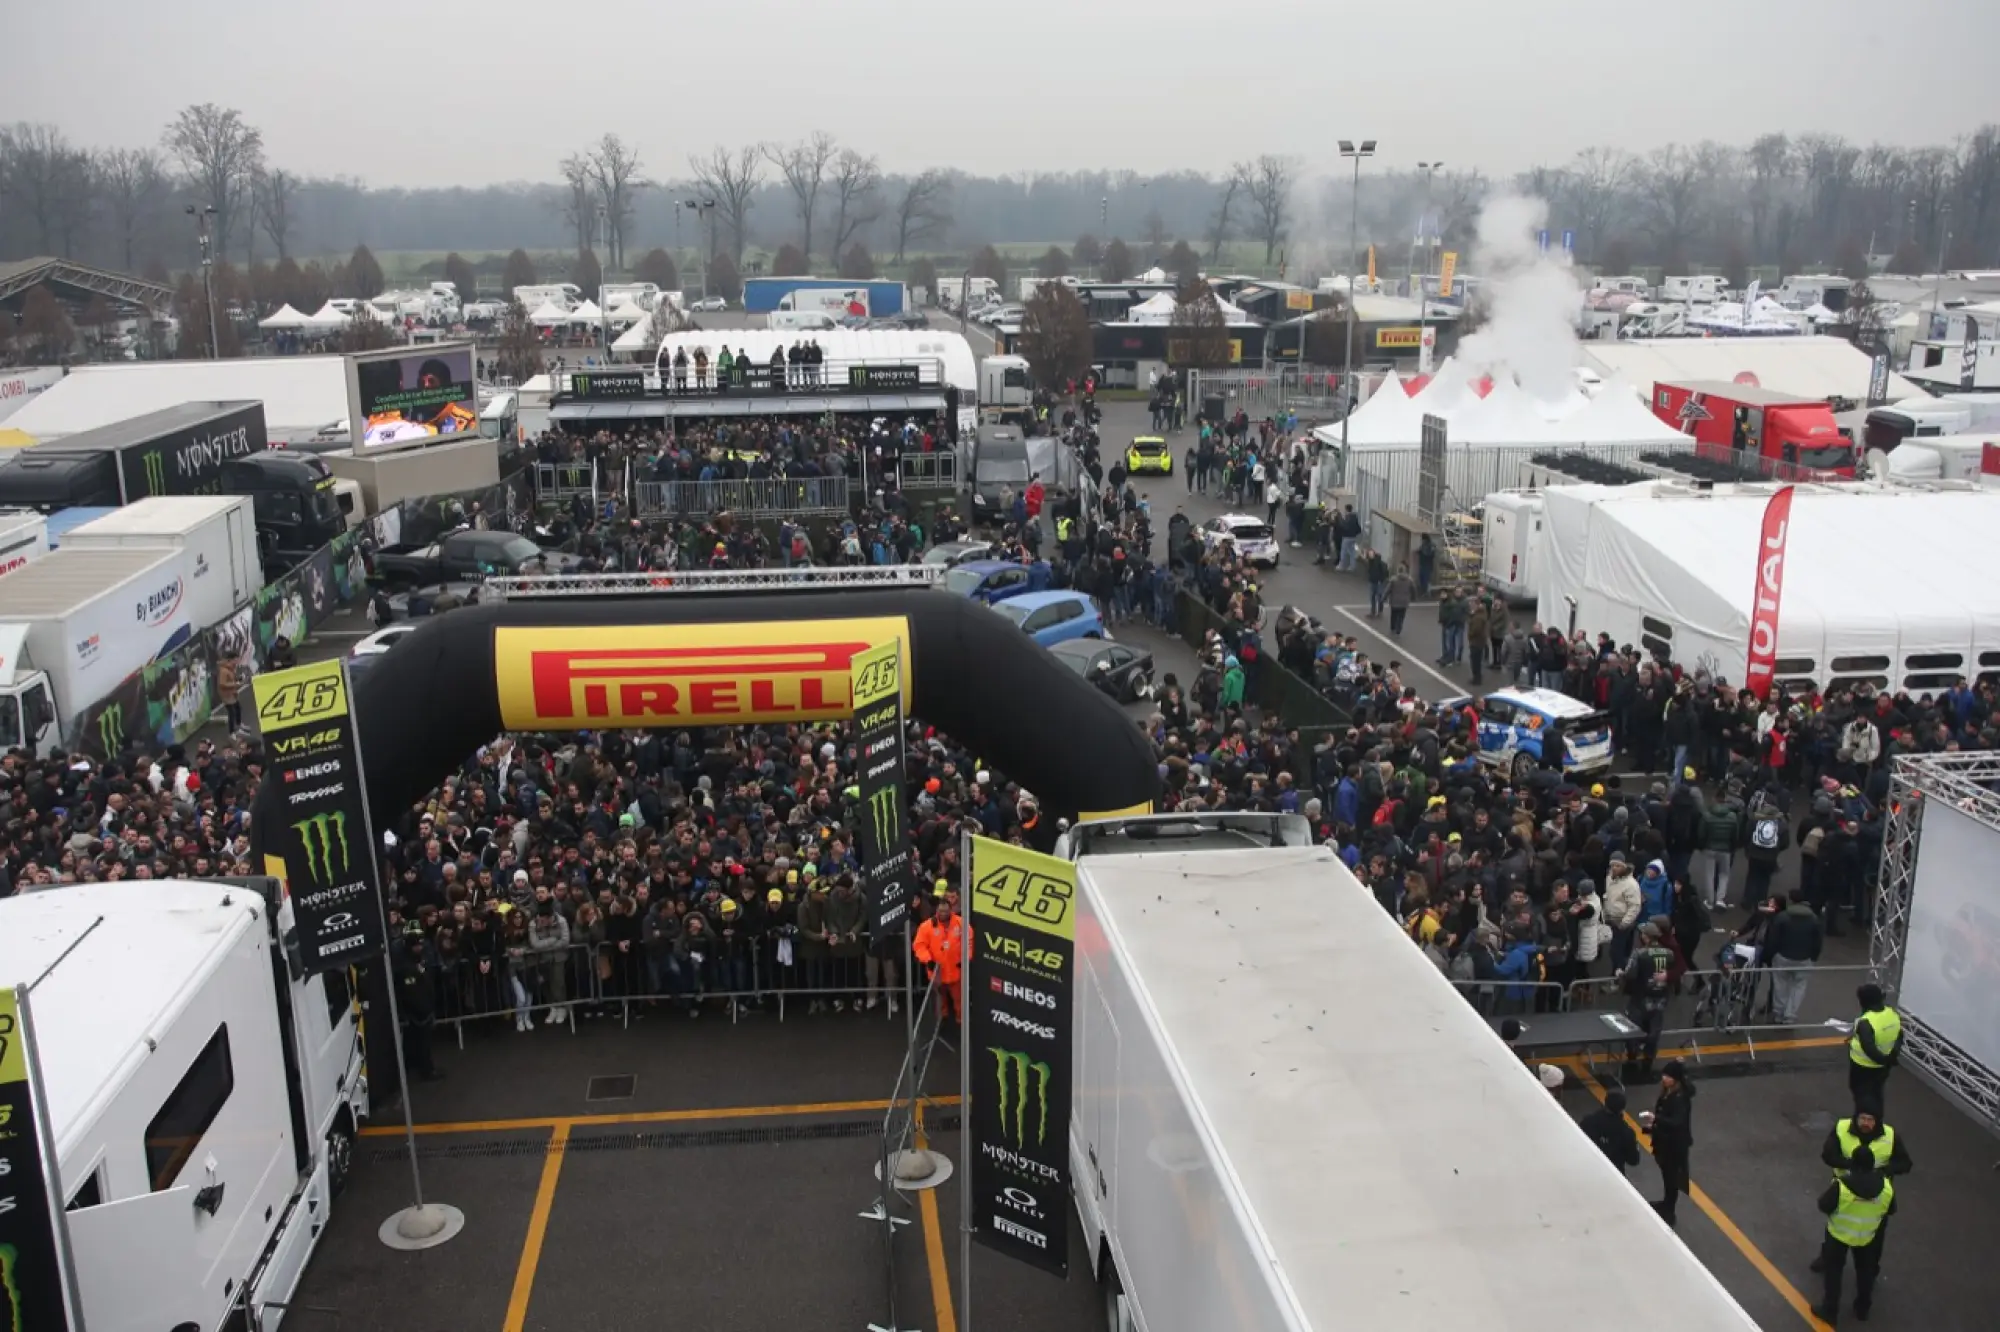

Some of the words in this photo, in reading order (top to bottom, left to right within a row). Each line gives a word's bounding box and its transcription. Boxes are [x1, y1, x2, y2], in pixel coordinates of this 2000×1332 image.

[176, 425, 251, 477] MONSTER
[532, 642, 872, 719] PIRELL
[853, 653, 898, 698] 46
[261, 675, 339, 721] 46
[295, 760, 341, 780] ENEOS
[975, 864, 1073, 925] 46
[319, 934, 364, 956] PIRELLI
[1003, 981, 1056, 1010] ENEOS
[990, 1009, 1055, 1039] TRAXXAS
[982, 1141, 1061, 1183] MONSTER
[995, 1195, 1045, 1219] OAKLEY
[993, 1214, 1047, 1249] PIRELLI
